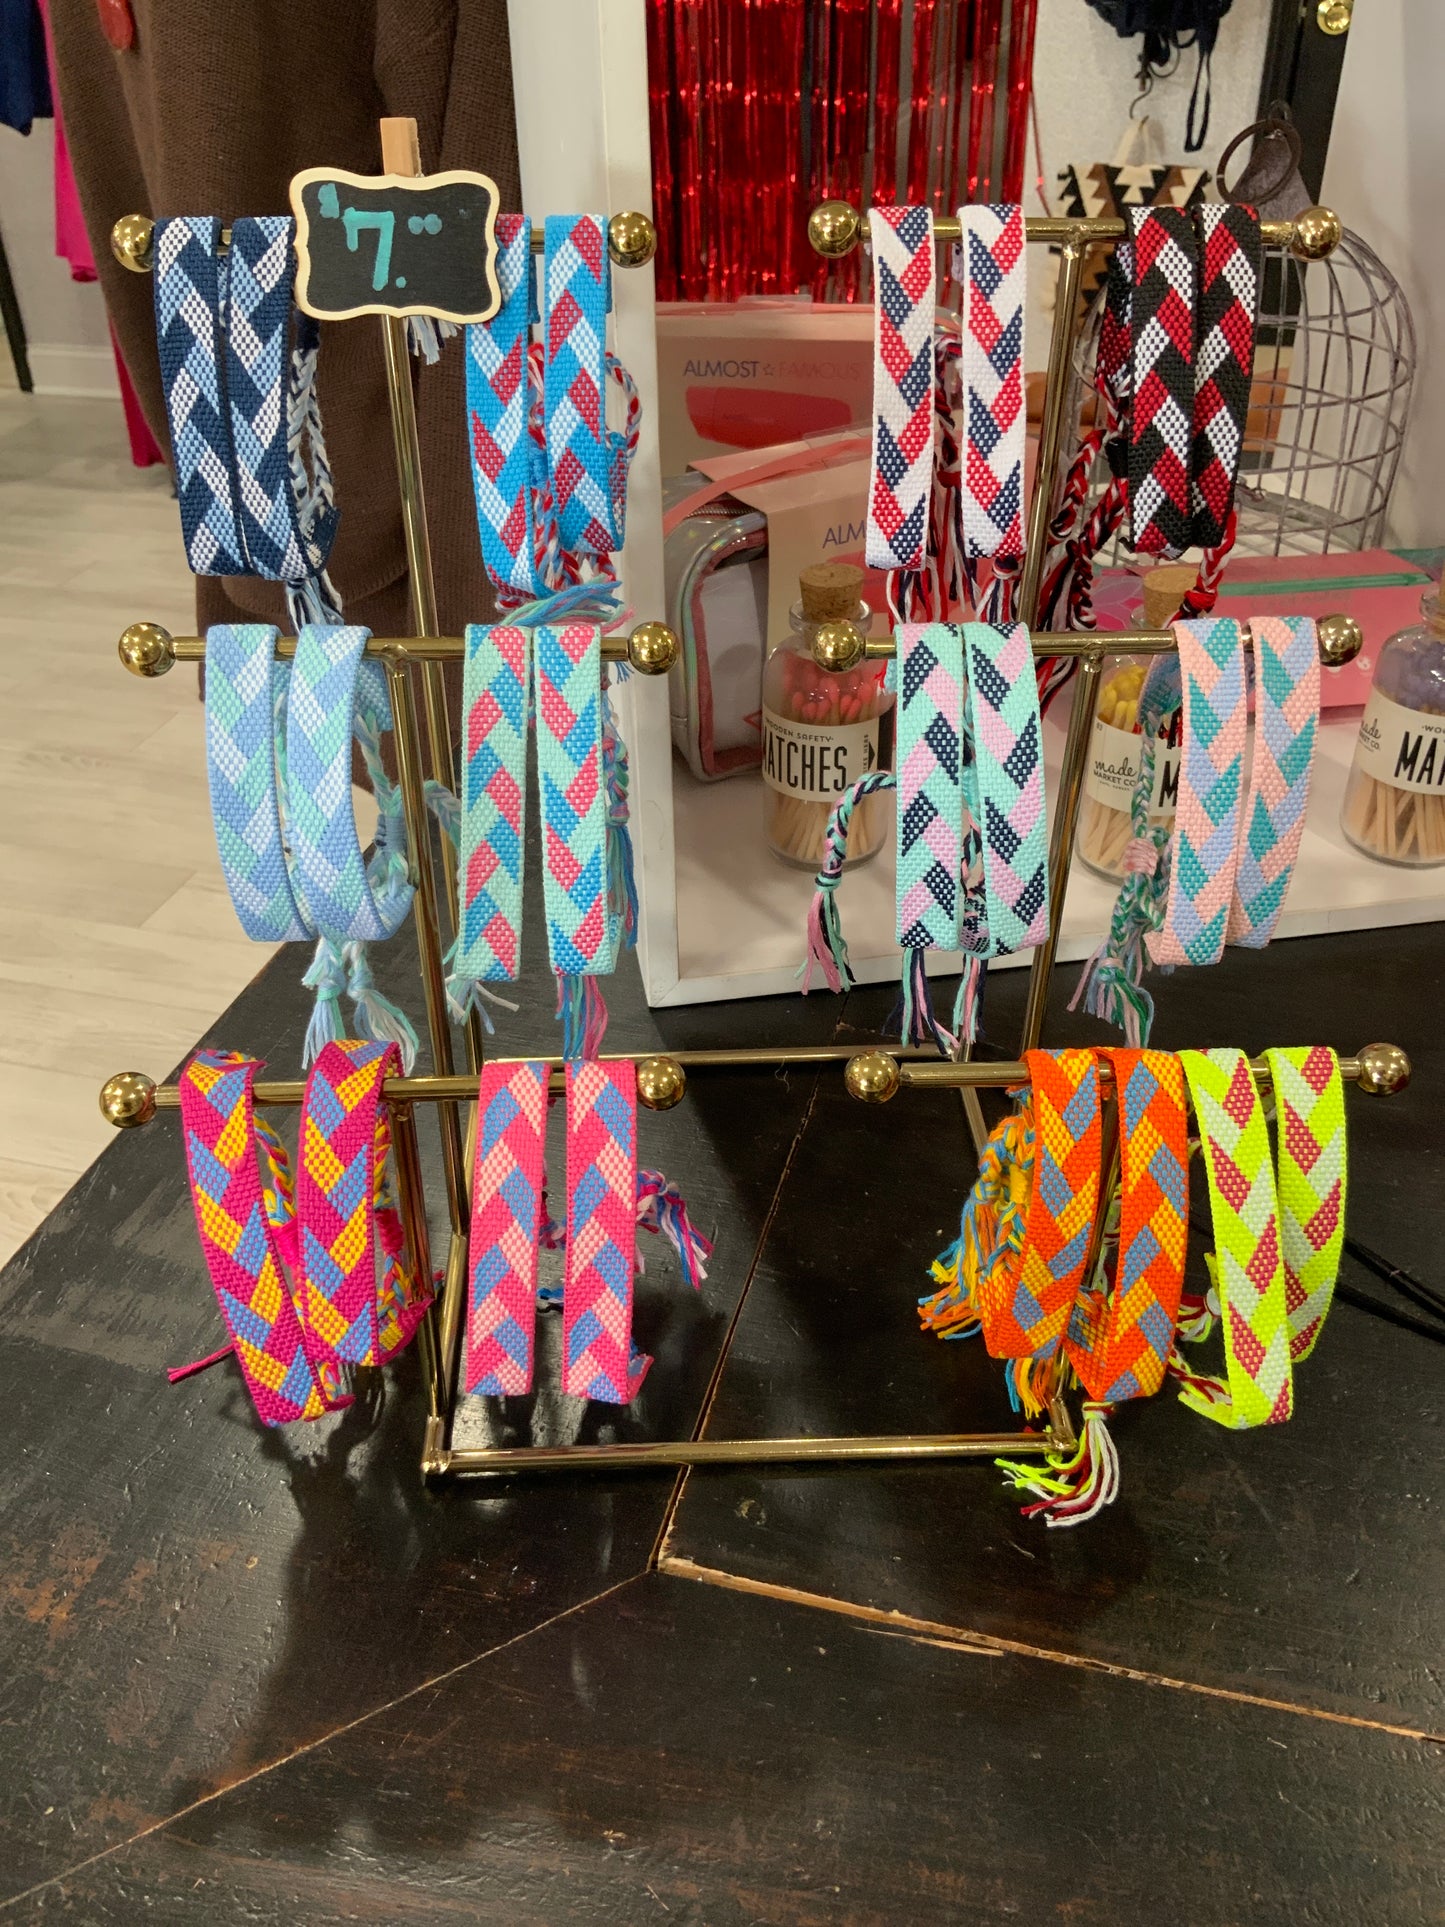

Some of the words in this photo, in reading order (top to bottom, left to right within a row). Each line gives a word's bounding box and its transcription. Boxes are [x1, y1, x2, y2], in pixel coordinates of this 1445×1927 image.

[683, 360, 760, 378] ALMOST
[796, 732, 832, 742] SAFETY
[1095, 757, 1137, 776] made
[1093, 769, 1121, 784] MARKET
